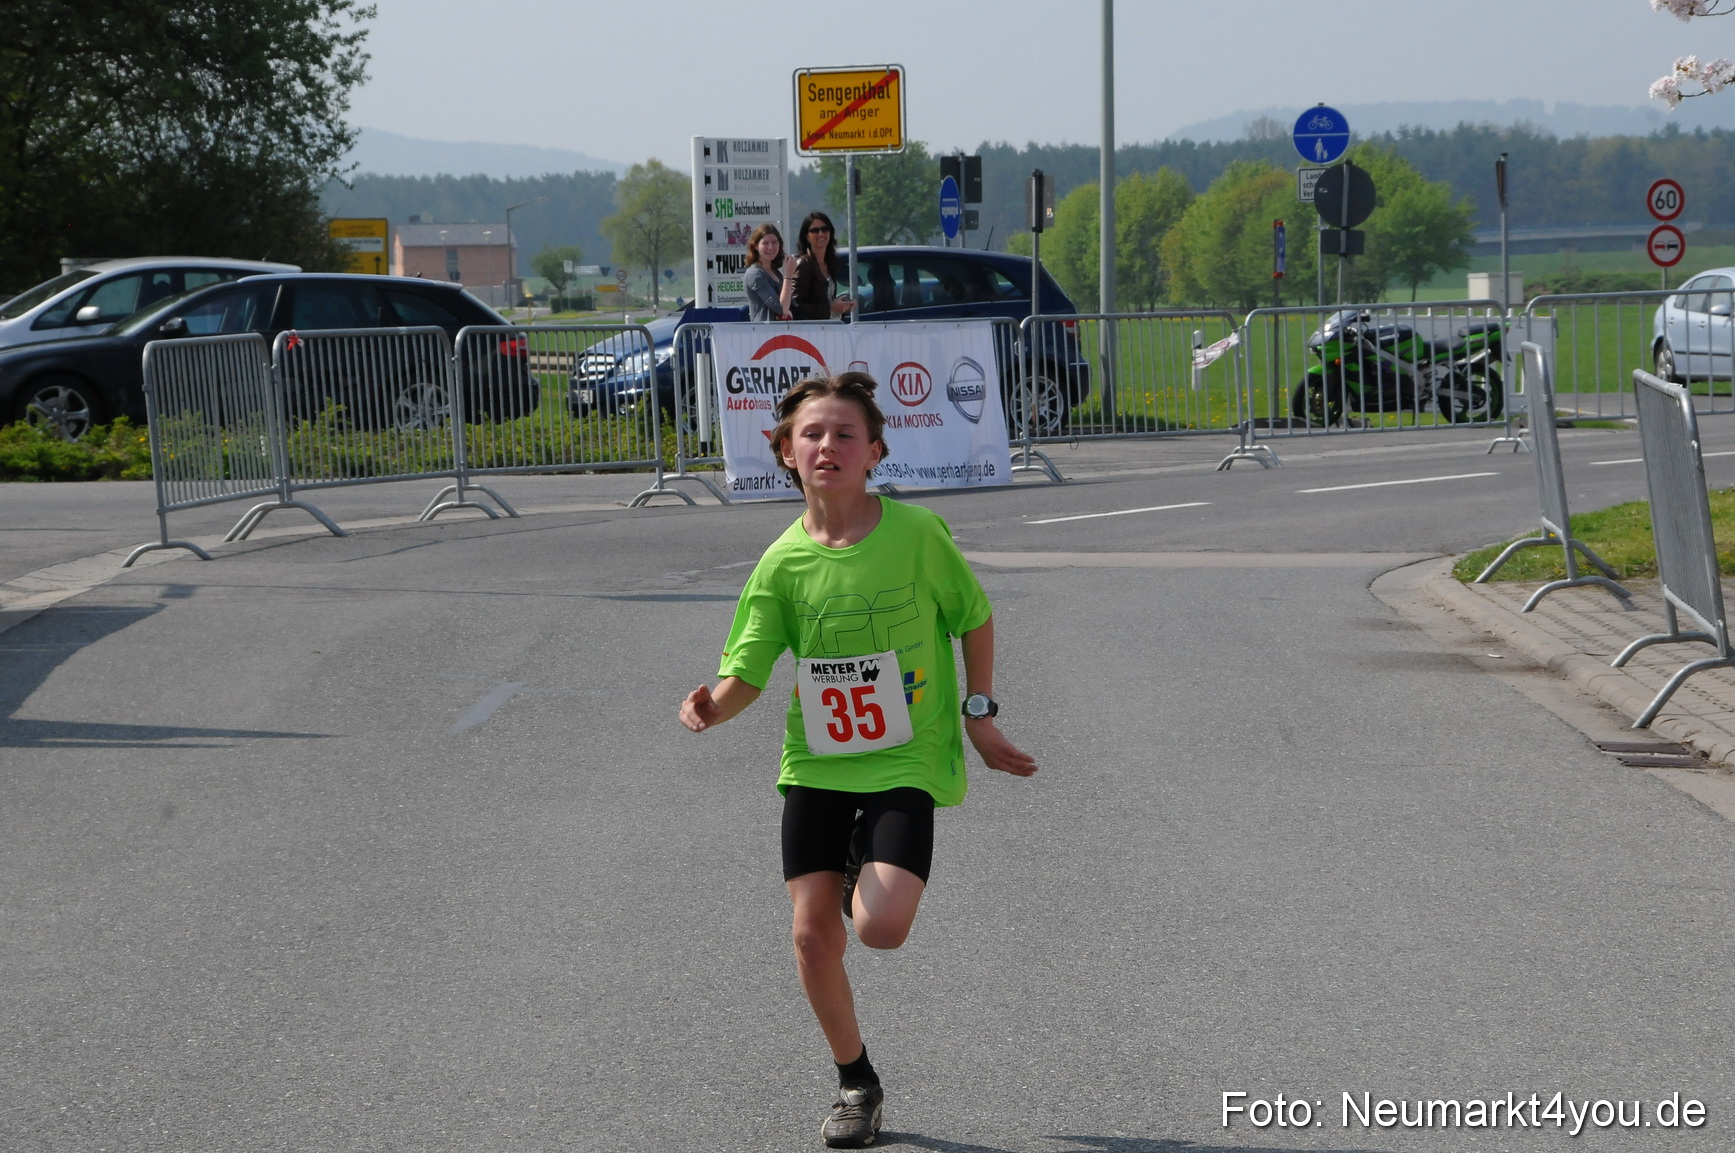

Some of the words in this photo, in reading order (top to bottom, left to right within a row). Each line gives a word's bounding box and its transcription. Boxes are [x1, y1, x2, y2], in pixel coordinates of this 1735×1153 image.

[808, 80, 890, 106] Sengenthal
[819, 108, 838, 119] am
[843, 106, 880, 121] Anger
[828, 128, 866, 140] Neumarkt
[733, 140, 769, 153] HOLZAMMER
[734, 169, 770, 181] HOLZAMMER
[1303, 180, 1317, 189] sch
[1655, 189, 1677, 210] 60
[715, 198, 734, 219] SHB
[735, 200, 771, 216] Holzfachmarkt
[897, 372, 924, 396] KIA
[726, 396, 772, 411] Autohaus
[886, 415, 903, 429] KIA
[904, 413, 944, 428] MOTORS
[905, 640, 924, 653] GmbH
[811, 661, 857, 675] MEYER
[811, 673, 859, 685] WERBUNG
[821, 684, 887, 743] 35
